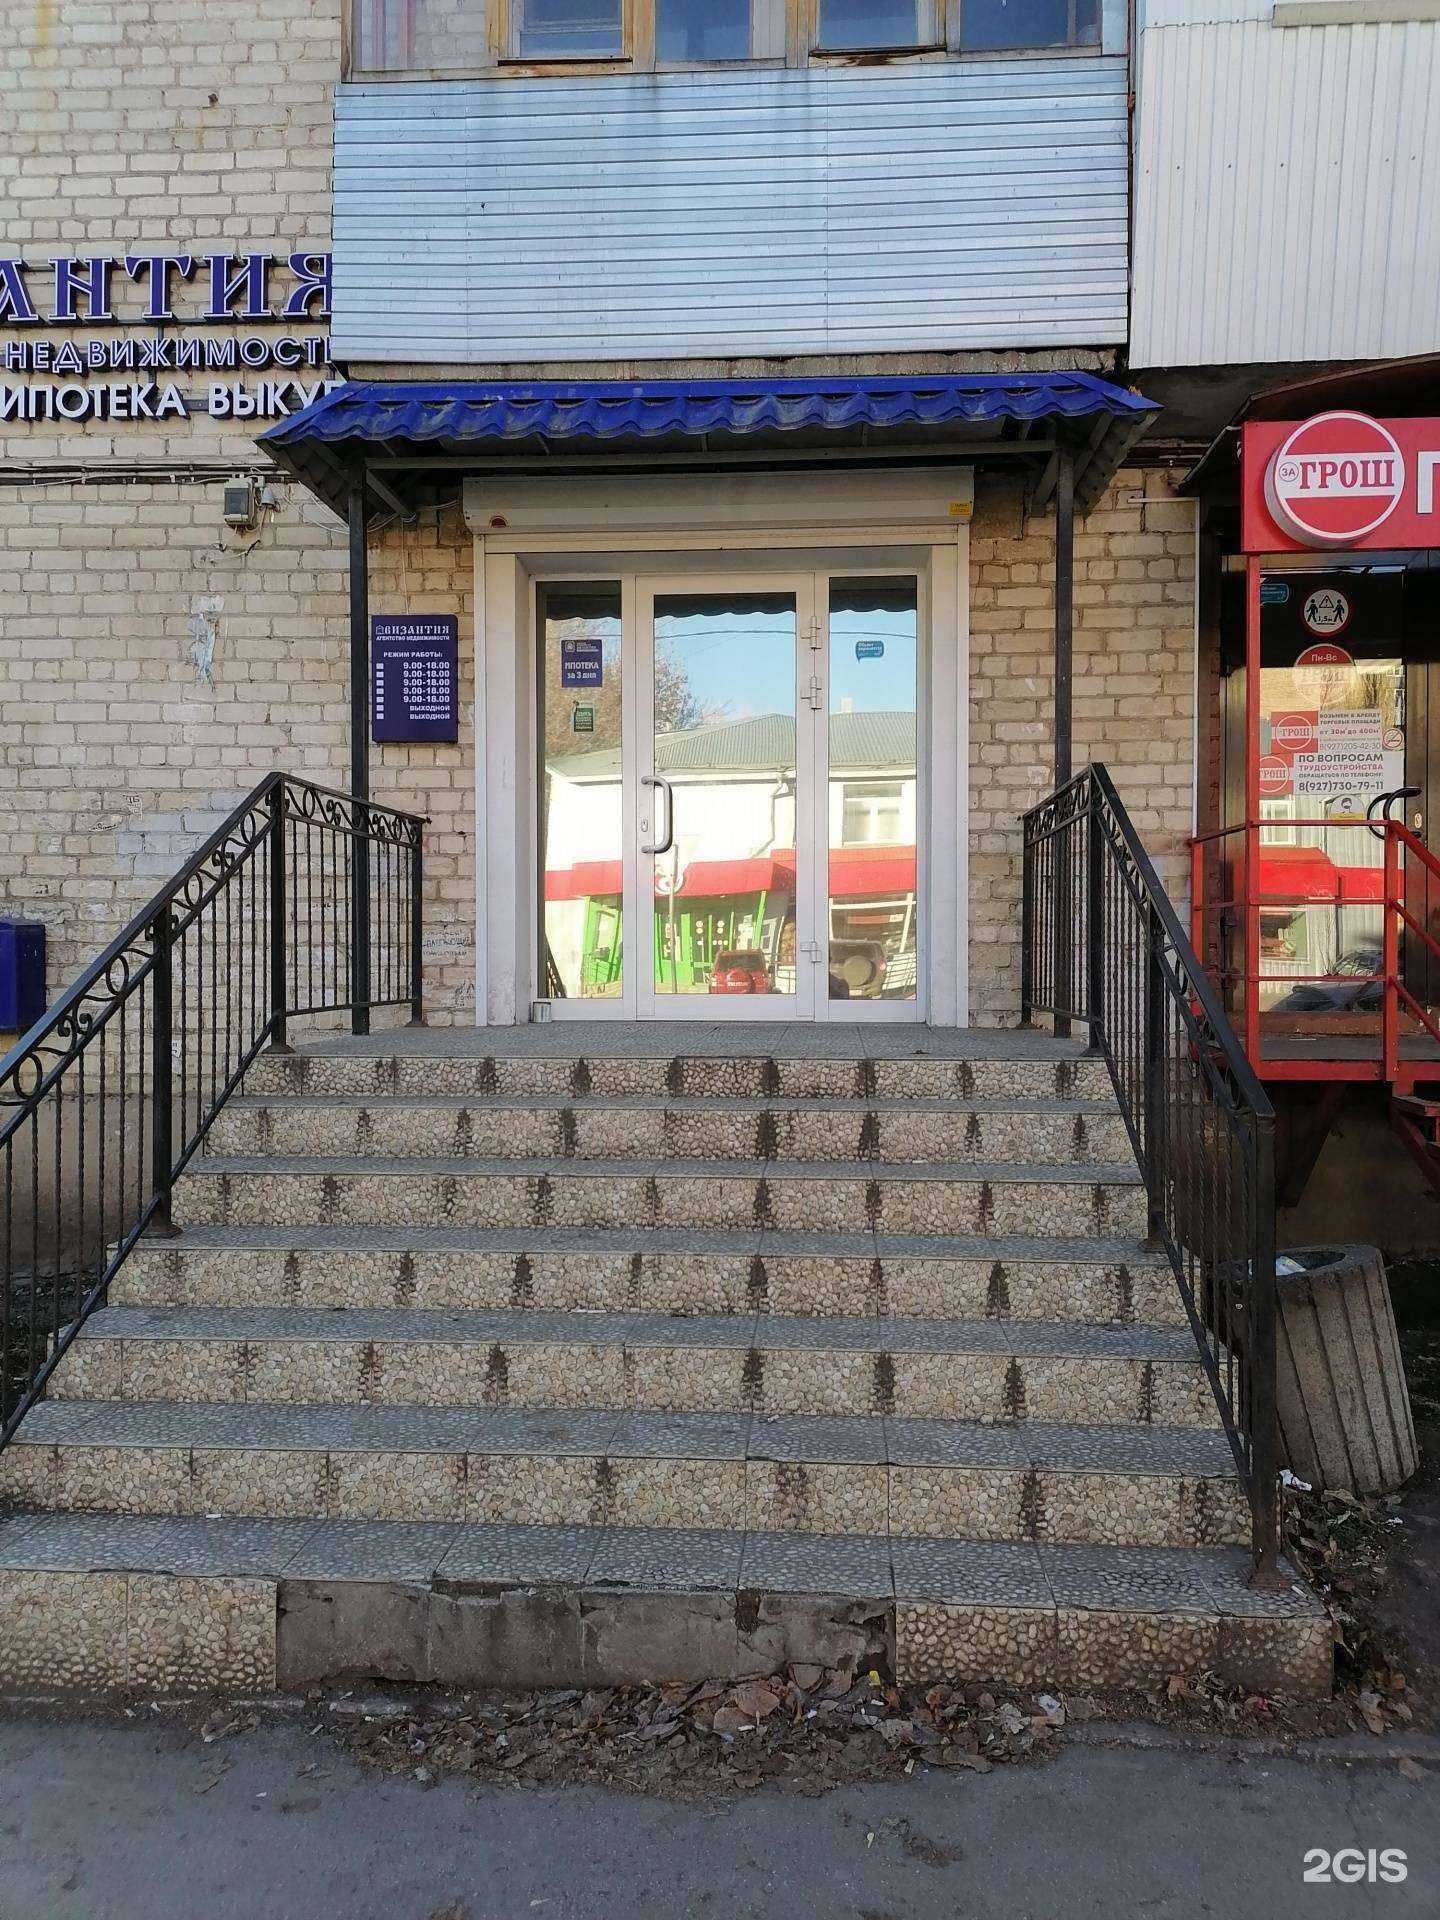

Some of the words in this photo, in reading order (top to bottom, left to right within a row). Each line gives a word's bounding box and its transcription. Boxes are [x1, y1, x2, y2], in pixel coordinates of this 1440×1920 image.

[5, 337, 331, 374] НЕДВИЖИМОСТ
[0, 382, 186, 418] ИПОТЕКА
[1281, 468, 1296, 478] ЗА
[1300, 460, 1395, 489] ГРОШ
[384, 625, 450, 635] ВИЗАНТИЯ
[564, 661, 599, 670] ИПОТЕКА
[403, 670, 450, 678] 9.00-18.00
[576, 671, 582, 679] 3
[403, 678, 450, 686] 9.00-18.00
[403, 687, 450, 695] 9.00-18.00
[403, 695, 450, 703] 9.00-18.00
[1282, 727, 1310, 736] ГРОШ
[1298, 754, 1315, 763] ПО
[1317, 753, 1384, 762] ВОПРОСАМ
[1298, 763, 1384, 772] ТРУДОУСТРОЙСТВА
[1298, 780, 1384, 792] 8(927)730-79-11
